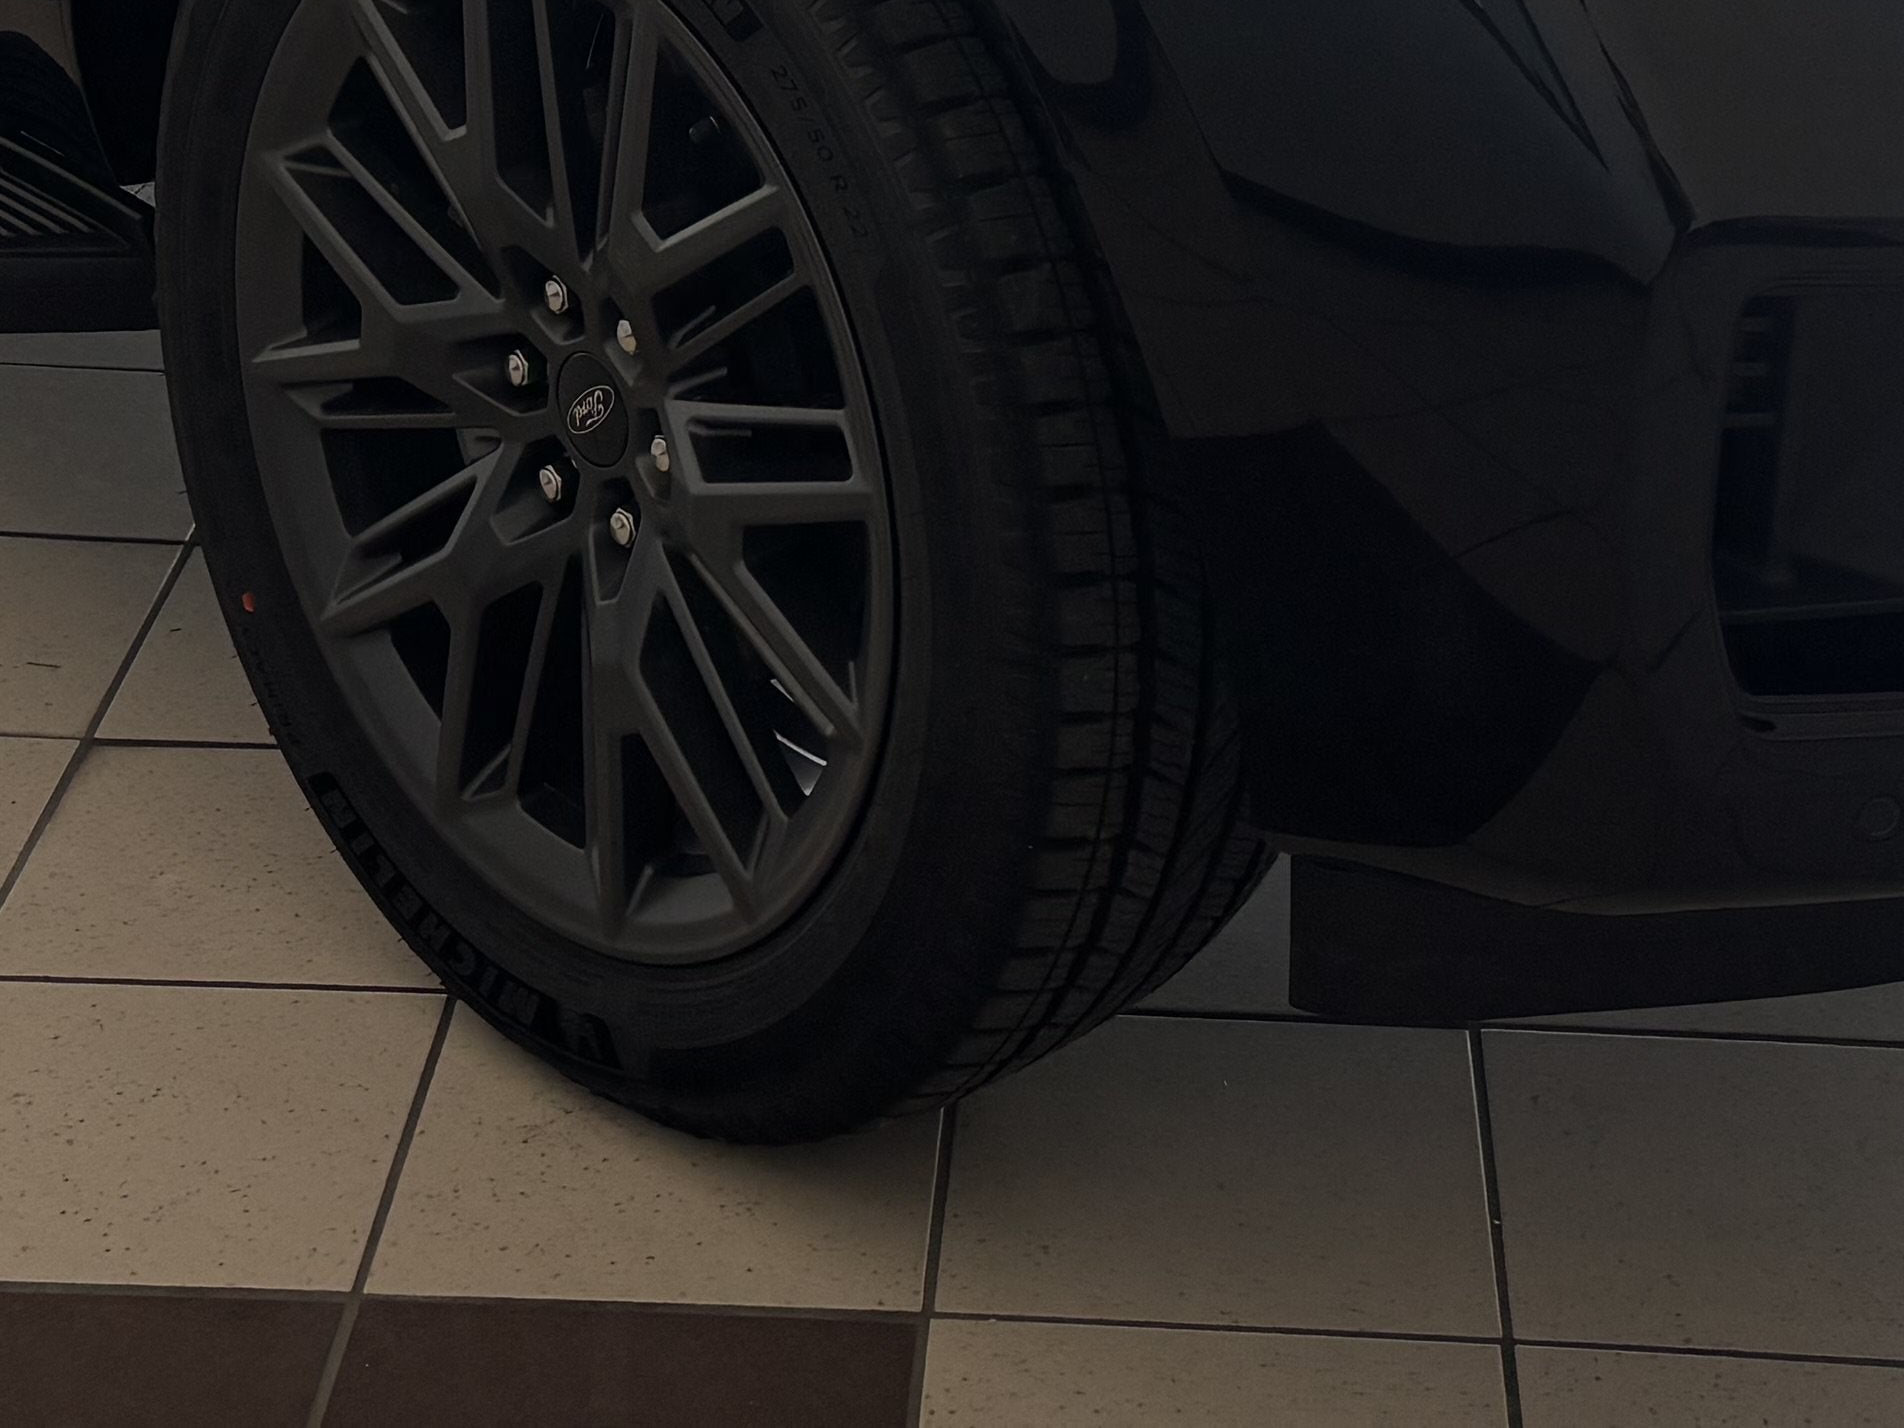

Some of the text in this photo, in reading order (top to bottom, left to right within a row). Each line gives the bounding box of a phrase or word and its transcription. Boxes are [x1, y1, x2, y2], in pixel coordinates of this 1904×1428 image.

[771, 64, 834, 163] 275/50
[829, 174, 849, 193] R
[572, 389, 605, 427] Ford
